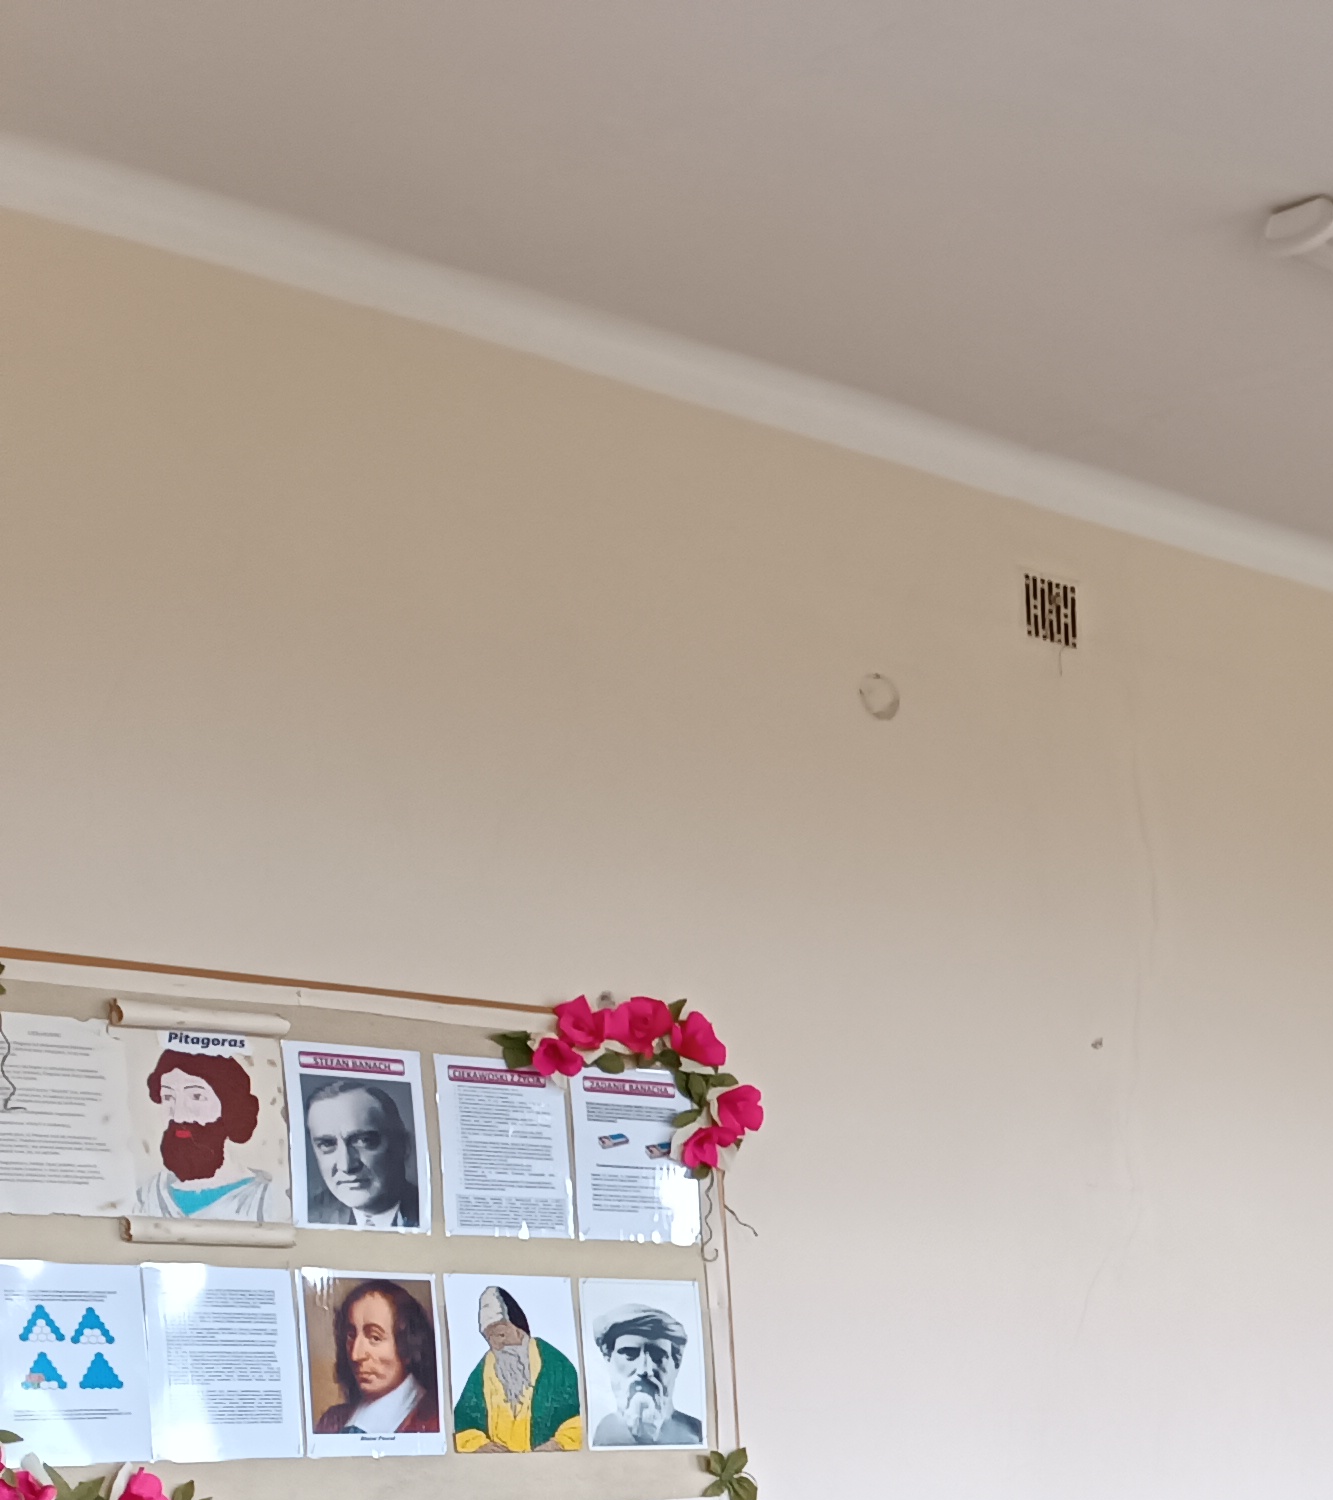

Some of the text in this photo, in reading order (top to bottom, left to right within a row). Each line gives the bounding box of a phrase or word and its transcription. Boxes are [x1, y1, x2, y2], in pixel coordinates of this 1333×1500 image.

[168, 1032, 245, 1048] Pitagoras
[313, 1057, 391, 1071] STEFAN BANACH
